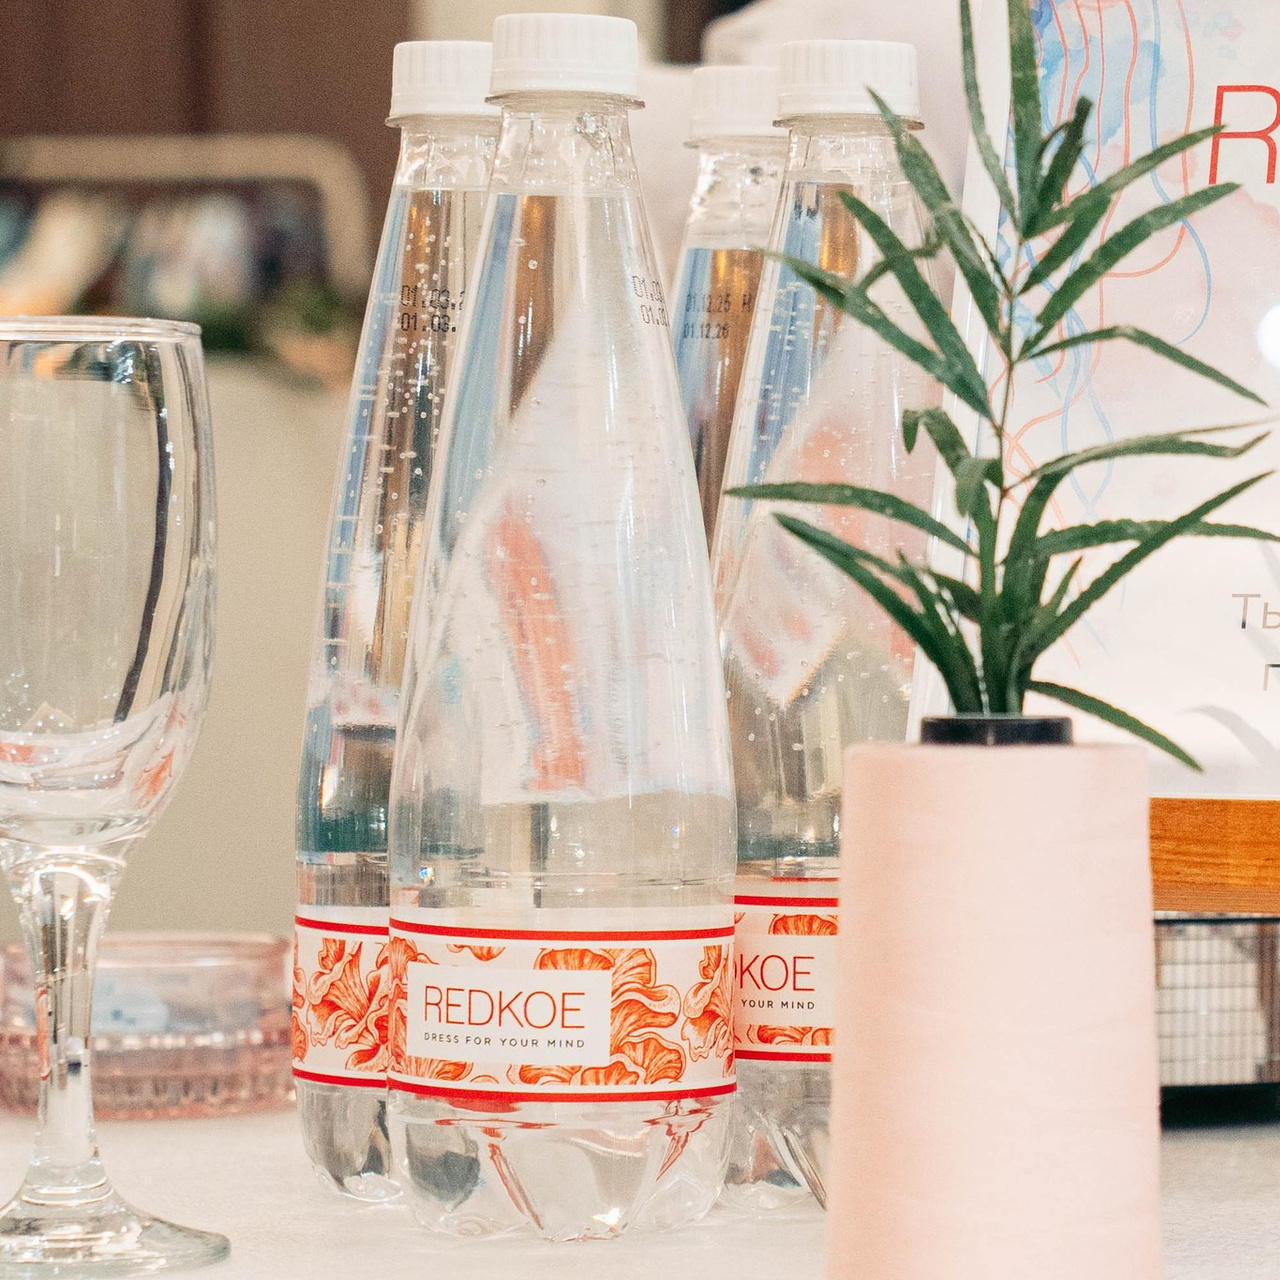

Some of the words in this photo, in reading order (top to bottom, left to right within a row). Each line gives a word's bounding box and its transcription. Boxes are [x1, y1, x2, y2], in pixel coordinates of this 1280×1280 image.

[734, 953, 816, 992] KOE
[424, 985, 586, 1029] REDKOE
[741, 999, 774, 1009] YOUR
[781, 1001, 815, 1010] MIND
[424, 1032, 459, 1044] DRESS
[465, 1036, 492, 1046] FOR
[499, 1038, 539, 1048] YOUR
[547, 1039, 585, 1049] MIND
